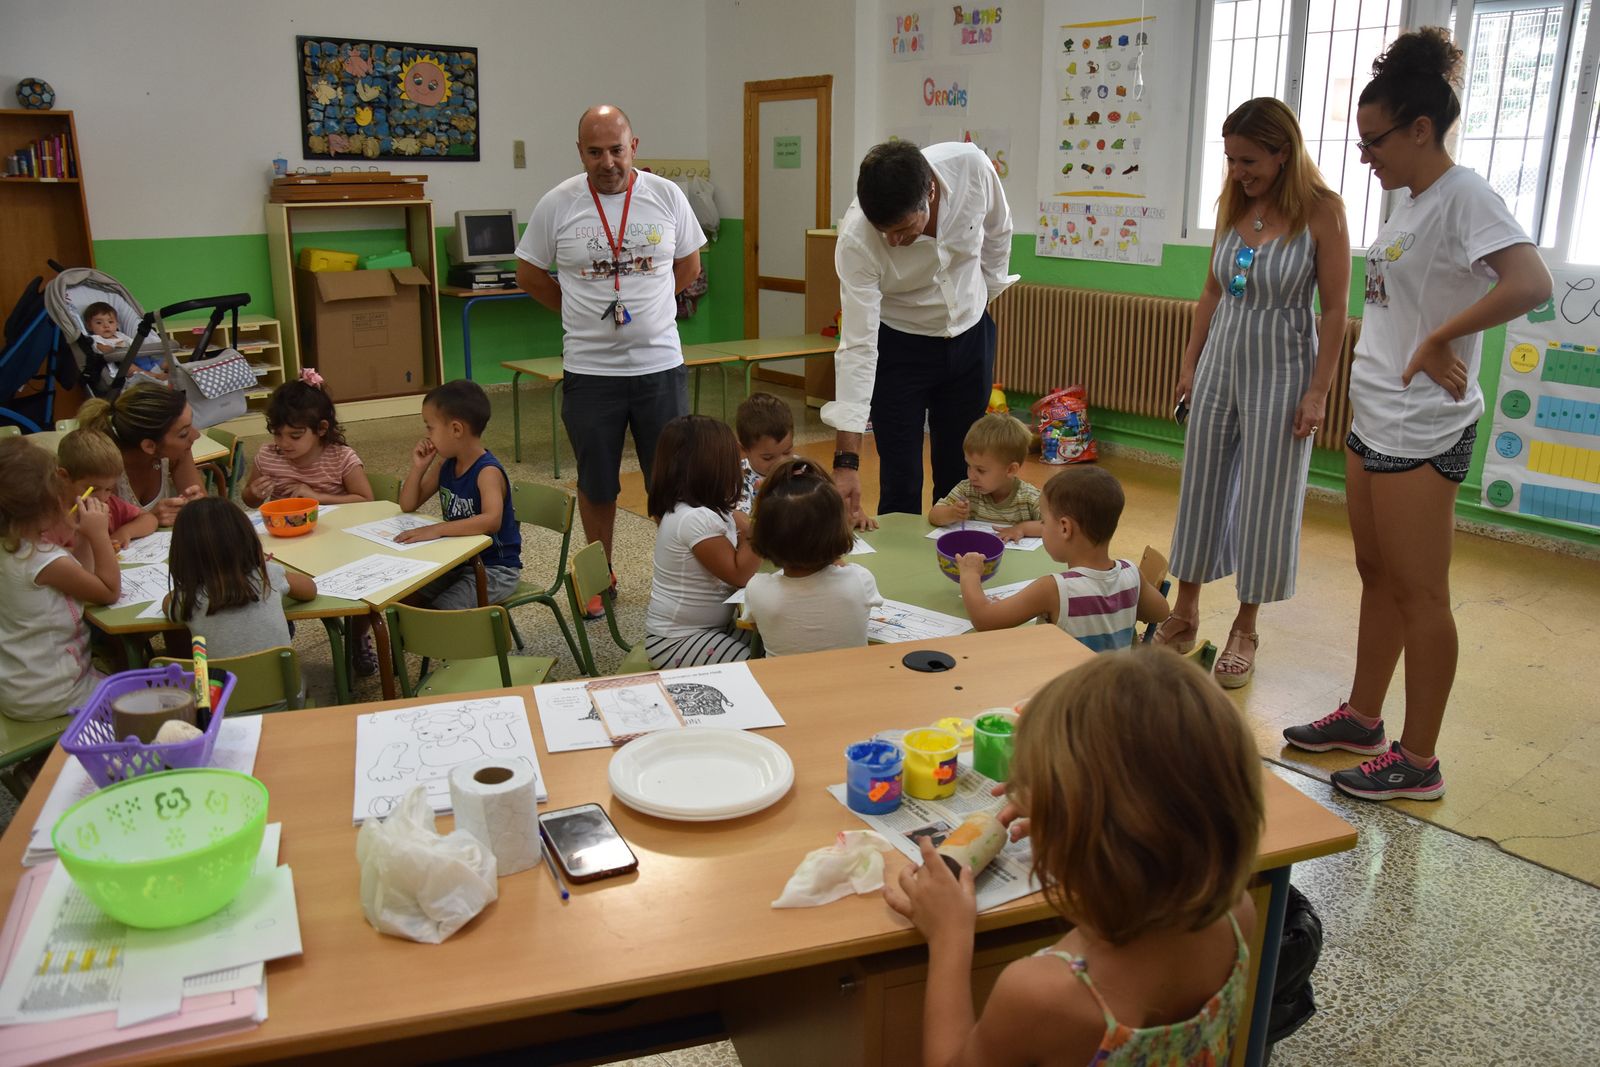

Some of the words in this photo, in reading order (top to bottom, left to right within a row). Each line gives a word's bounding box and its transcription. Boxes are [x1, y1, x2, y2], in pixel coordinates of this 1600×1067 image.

[896, 12, 919, 34] POR
[892, 33, 925, 54] FAVOR
[1520, 353, 1526, 362] 1
[1512, 399, 1519, 408] 2
